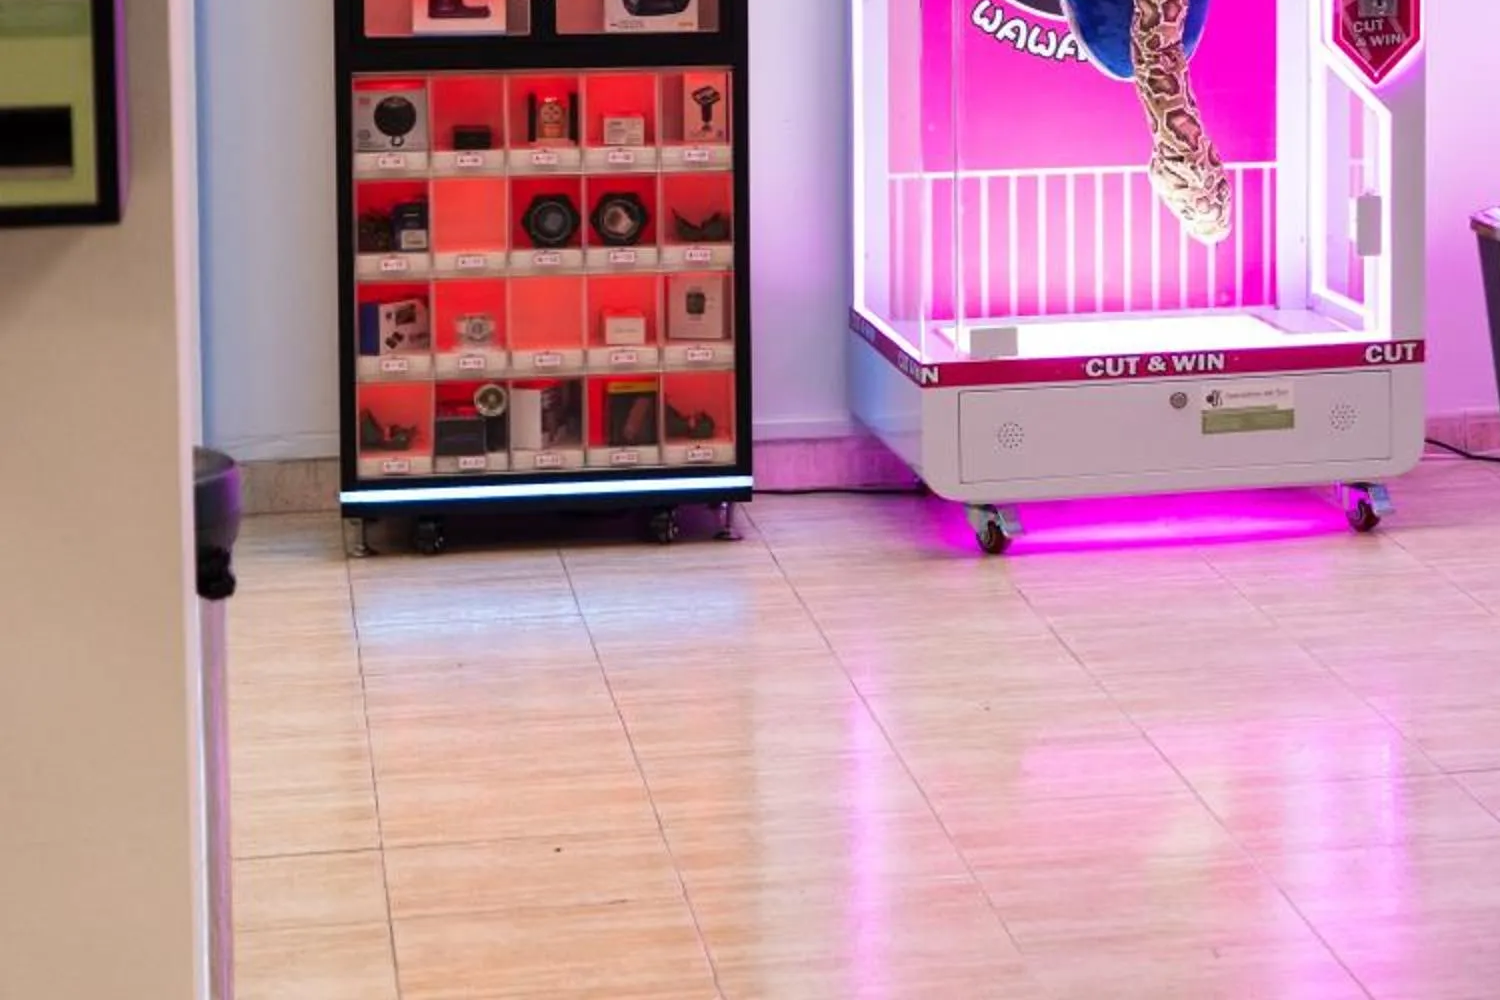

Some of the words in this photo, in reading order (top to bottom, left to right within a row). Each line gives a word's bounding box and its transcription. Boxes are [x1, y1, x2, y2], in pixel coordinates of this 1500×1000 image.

[1353, 19, 1384, 33] CUT
[1369, 33, 1401, 47] WIN
[1365, 342, 1417, 363] CUT
[1085, 356, 1139, 377] CUT
[1148, 355, 1166, 373] &
[1172, 353, 1225, 372] WIN
